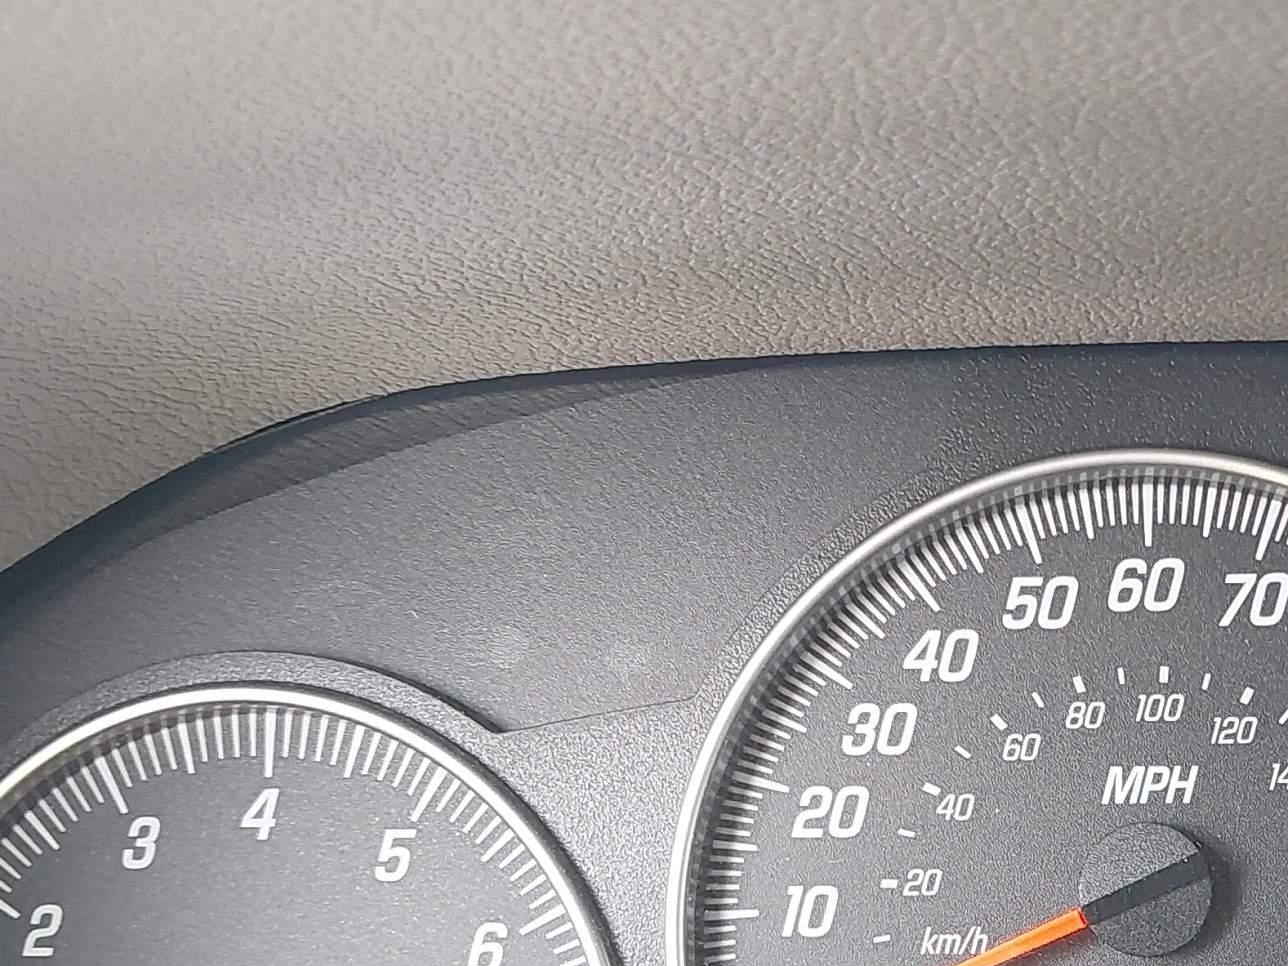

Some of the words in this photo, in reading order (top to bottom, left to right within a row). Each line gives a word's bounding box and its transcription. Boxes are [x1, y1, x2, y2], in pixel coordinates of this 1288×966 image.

[1002, 576, 1079, 629] 50
[1107, 558, 1185, 613] 60
[903, 629, 979, 683] 40
[841, 702, 917, 756] 30
[1065, 701, 1105, 730] 80
[1135, 694, 1184, 722] 100
[1210, 717, 1257, 745] 120
[1002, 734, 1041, 762] 60
[936, 794, 975, 821] 40
[1102, 766, 1199, 804] MPH
[241, 788, 279, 840] 4
[791, 786, 870, 839] 20
[122, 817, 160, 869] 3
[375, 828, 416, 881] 5
[903, 869, 942, 897] 20
[21, 904, 63, 957] 2
[782, 886, 839, 938] 10
[920, 926, 989, 955] km/h
